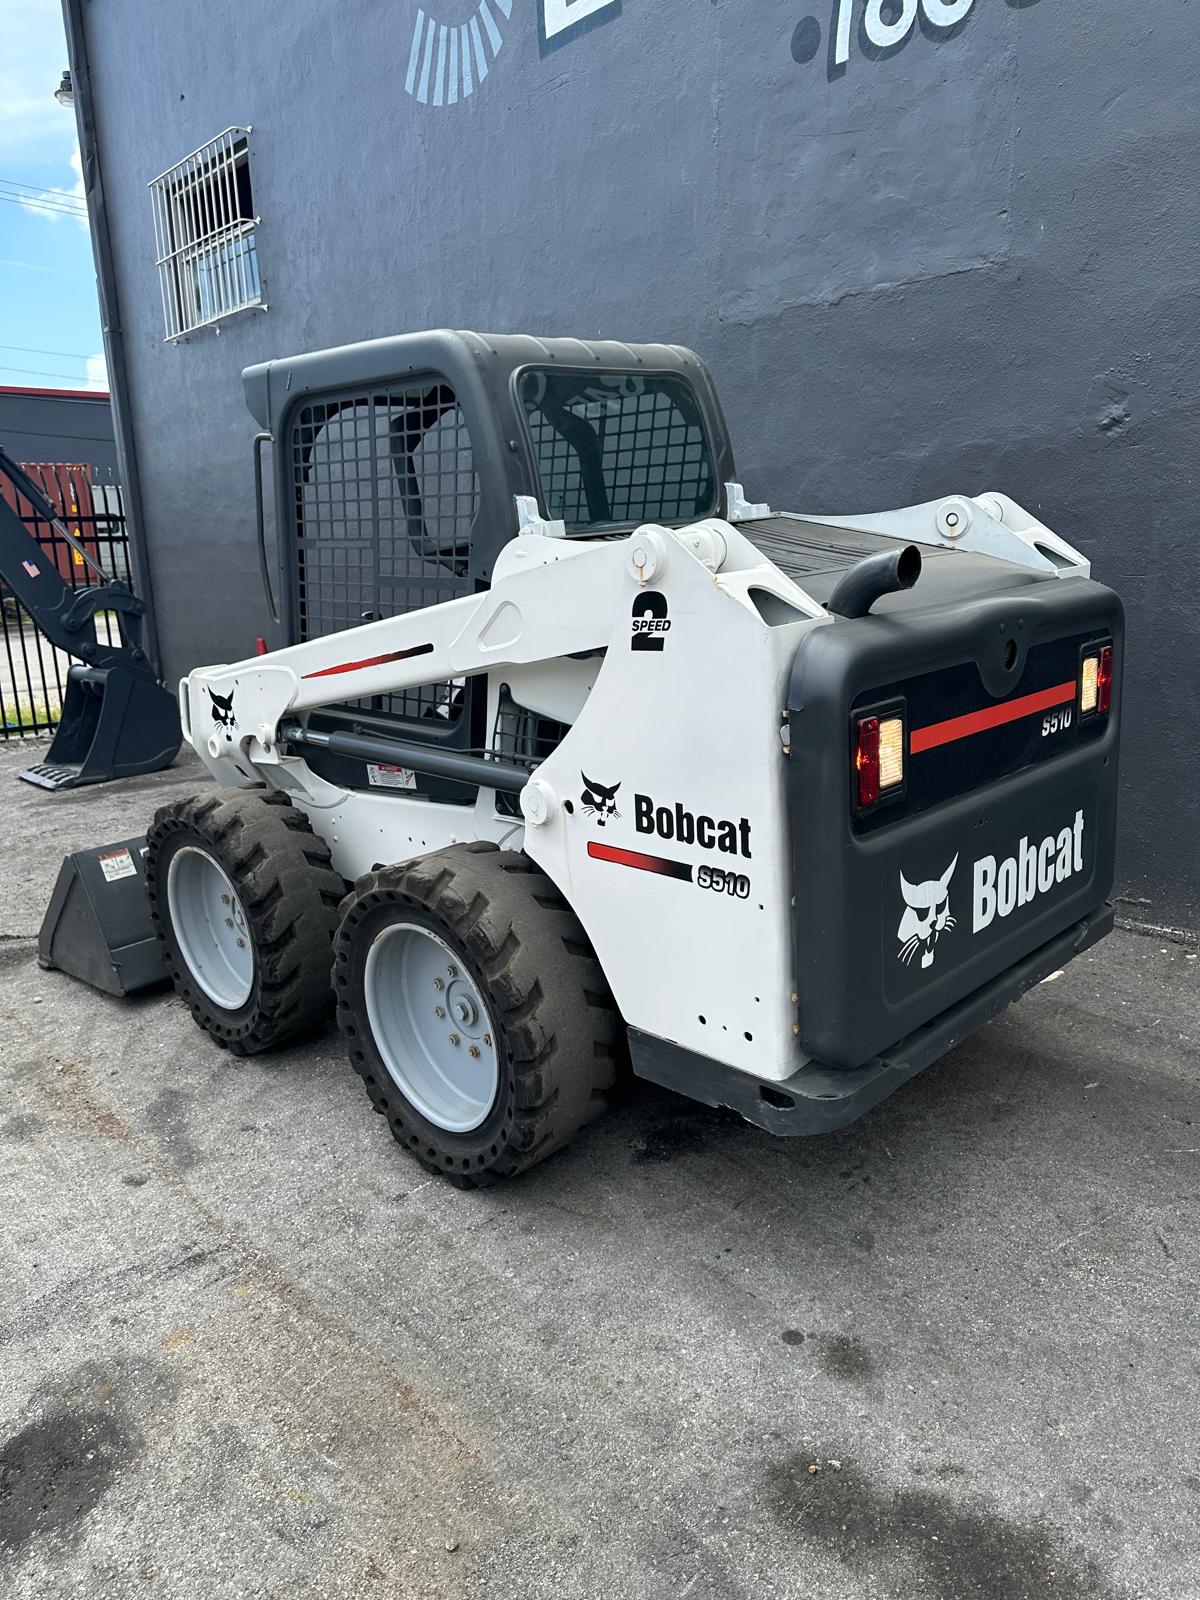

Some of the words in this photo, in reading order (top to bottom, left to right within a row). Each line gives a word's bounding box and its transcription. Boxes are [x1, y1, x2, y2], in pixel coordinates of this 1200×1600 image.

[631, 591, 668, 651] 2
[632, 620, 671, 631] SPEED
[1042, 708, 1072, 737] S510
[635, 794, 752, 859] Bobcat
[697, 865, 751, 899] S510
[973, 809, 1084, 934] Bobcat
